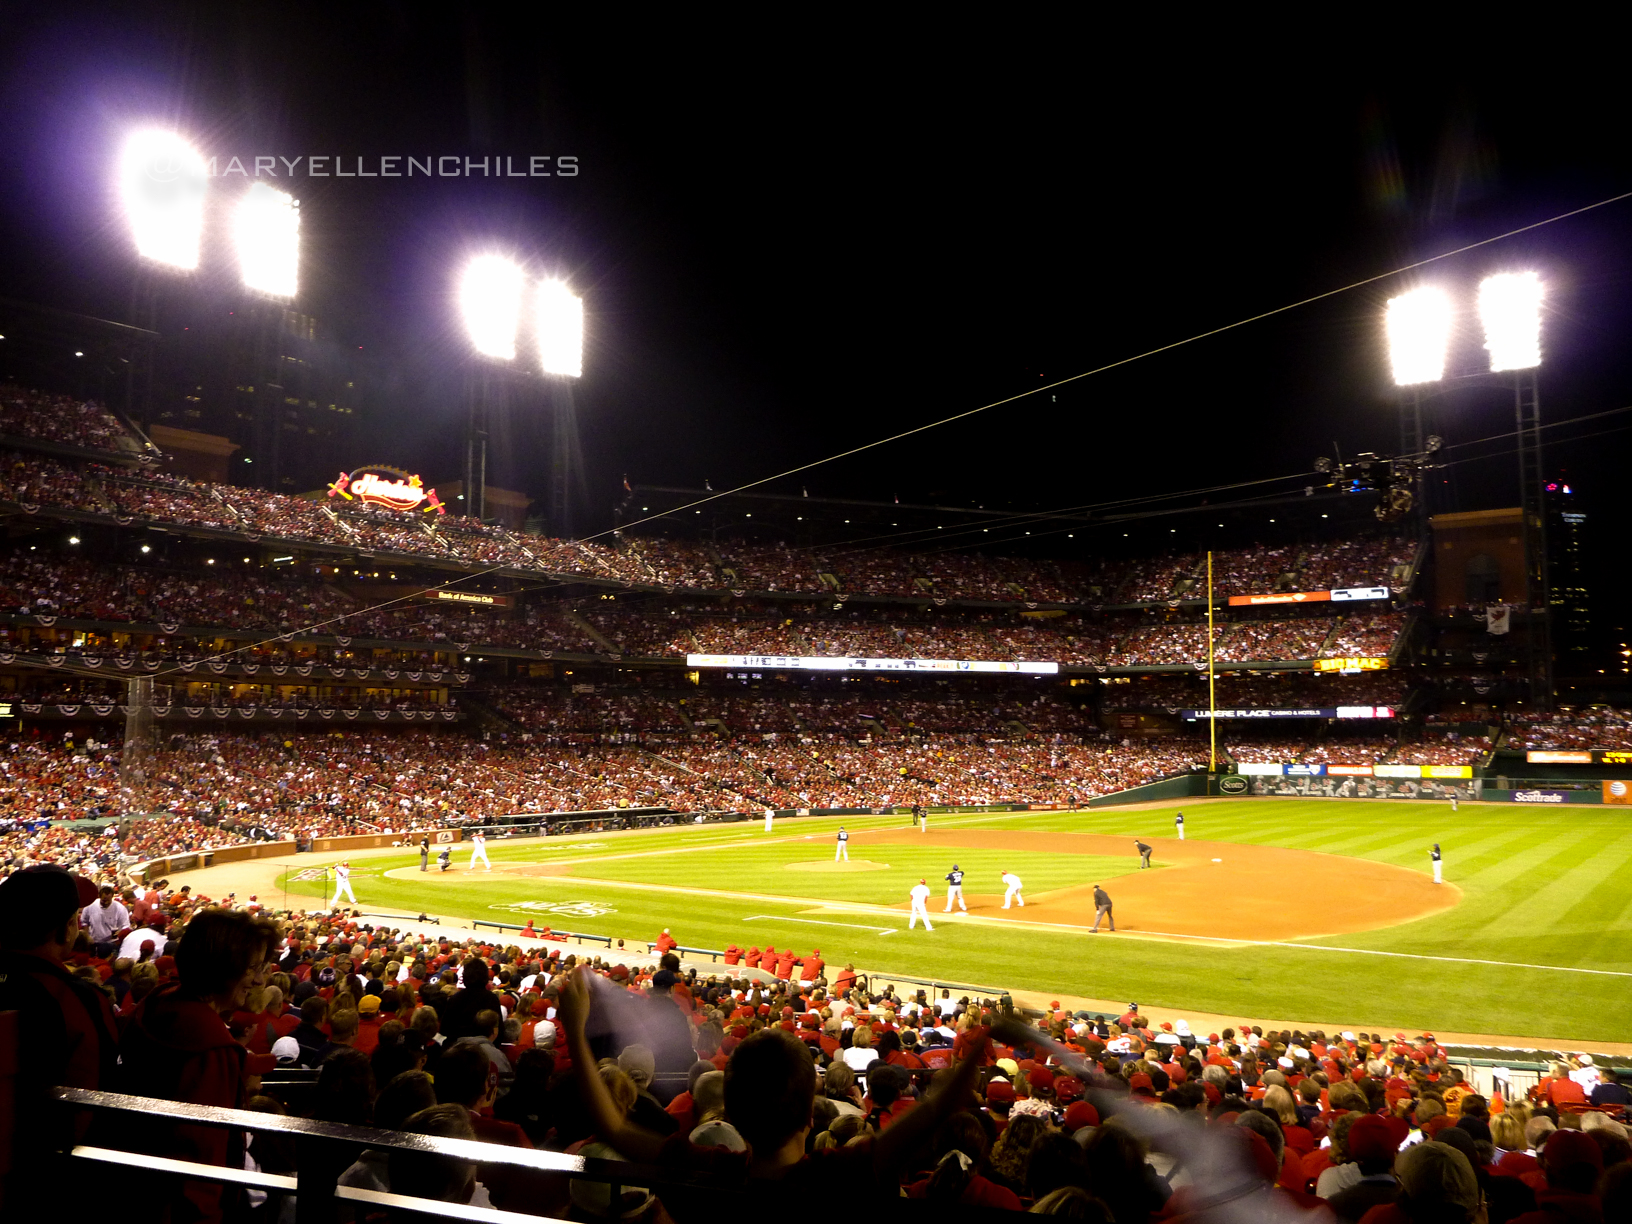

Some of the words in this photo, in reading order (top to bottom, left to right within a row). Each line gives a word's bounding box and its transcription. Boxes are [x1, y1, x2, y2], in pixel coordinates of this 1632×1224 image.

[482, 596, 494, 604] Club
[1320, 658, 1345, 671] BIG
[1345, 657, 1381, 670] MAC
[1236, 710, 1270, 718] PLACE
[1223, 780, 1245, 789] Scotts
[1514, 790, 1563, 803] Scottrade
